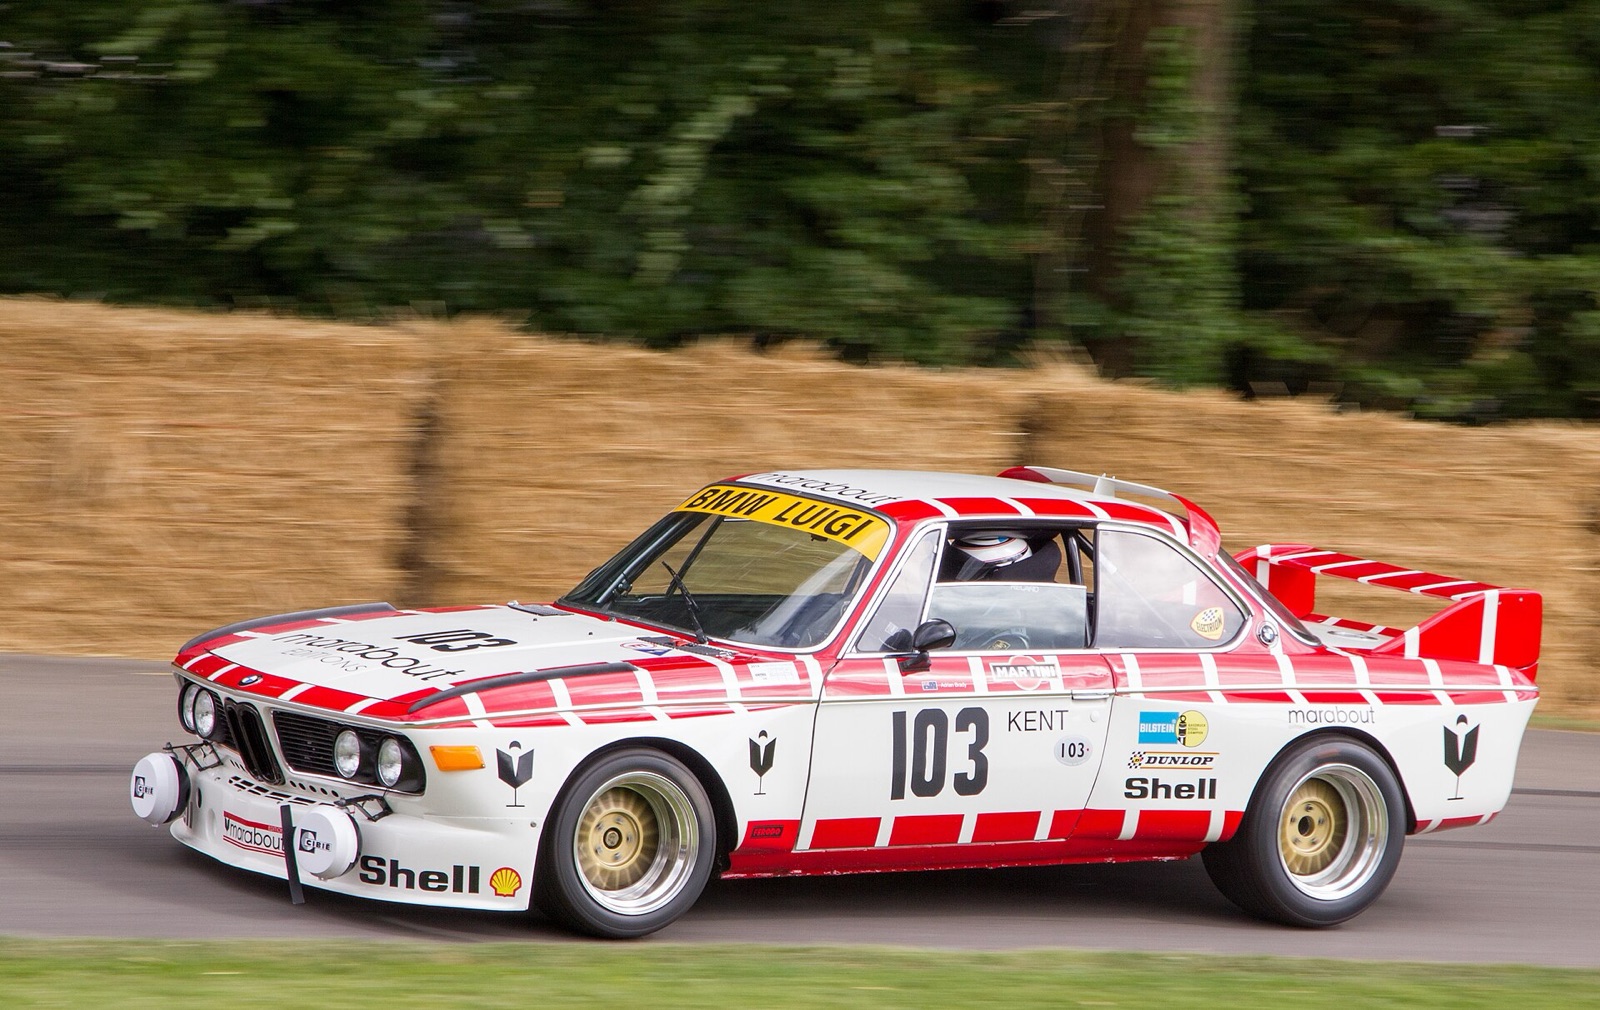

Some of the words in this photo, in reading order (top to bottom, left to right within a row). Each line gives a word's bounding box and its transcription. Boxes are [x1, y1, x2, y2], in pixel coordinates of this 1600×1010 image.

[748, 473, 903, 504] marabout
[685, 488, 779, 516] BMW
[772, 501, 875, 541] LUIGI
[391, 629, 518, 652] 103
[272, 633, 465, 681] marabout
[281, 648, 367, 673] EDITIONS
[994, 665, 1056, 678] MARTINI
[1008, 710, 1069, 732] KENT
[1288, 706, 1375, 724] marabout
[1140, 722, 1175, 733] BILSTEIN
[890, 706, 990, 801] 103
[1061, 742, 1085, 758] 103
[1145, 756, 1214, 765] DUNLOP
[1124, 777, 1217, 799] Shell
[359, 854, 480, 894] Shell
